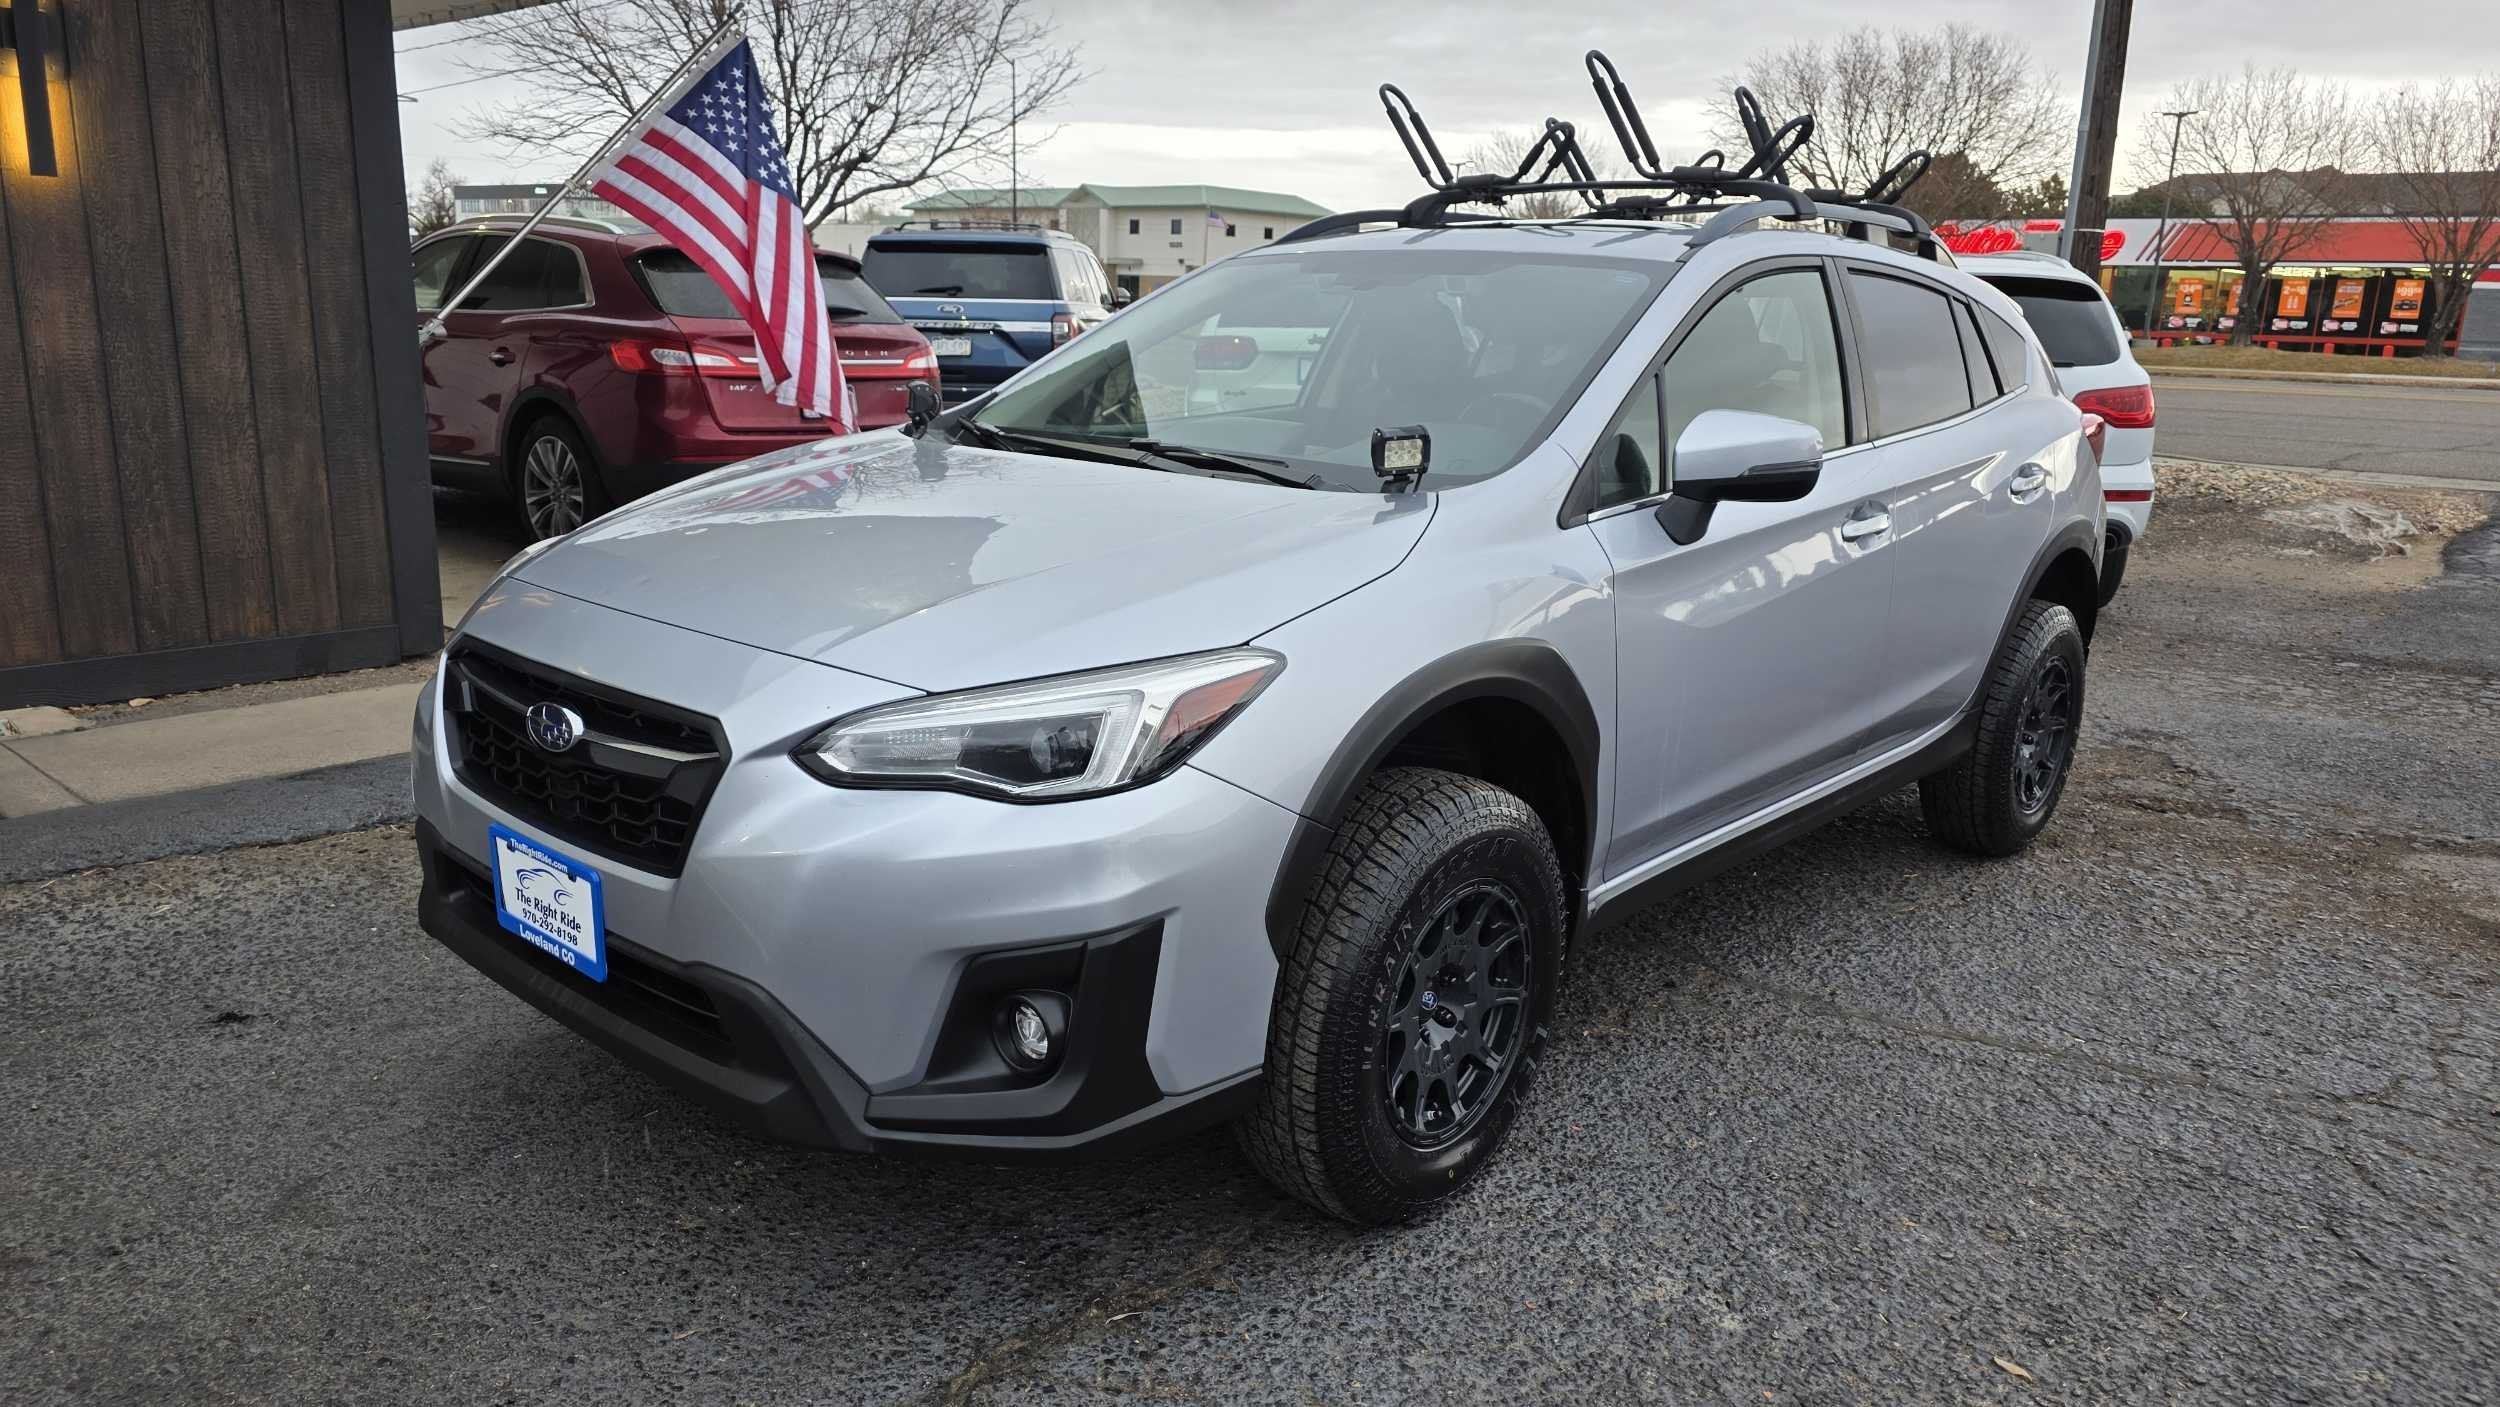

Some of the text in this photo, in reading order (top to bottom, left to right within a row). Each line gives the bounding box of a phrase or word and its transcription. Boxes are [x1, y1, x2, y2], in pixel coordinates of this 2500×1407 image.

[510, 838, 568, 873] TheRightRide.com
[515, 887, 582, 933] The Right Ride
[522, 907, 578, 946] 970-292-8198
[519, 924, 576, 966] Loveland CO
